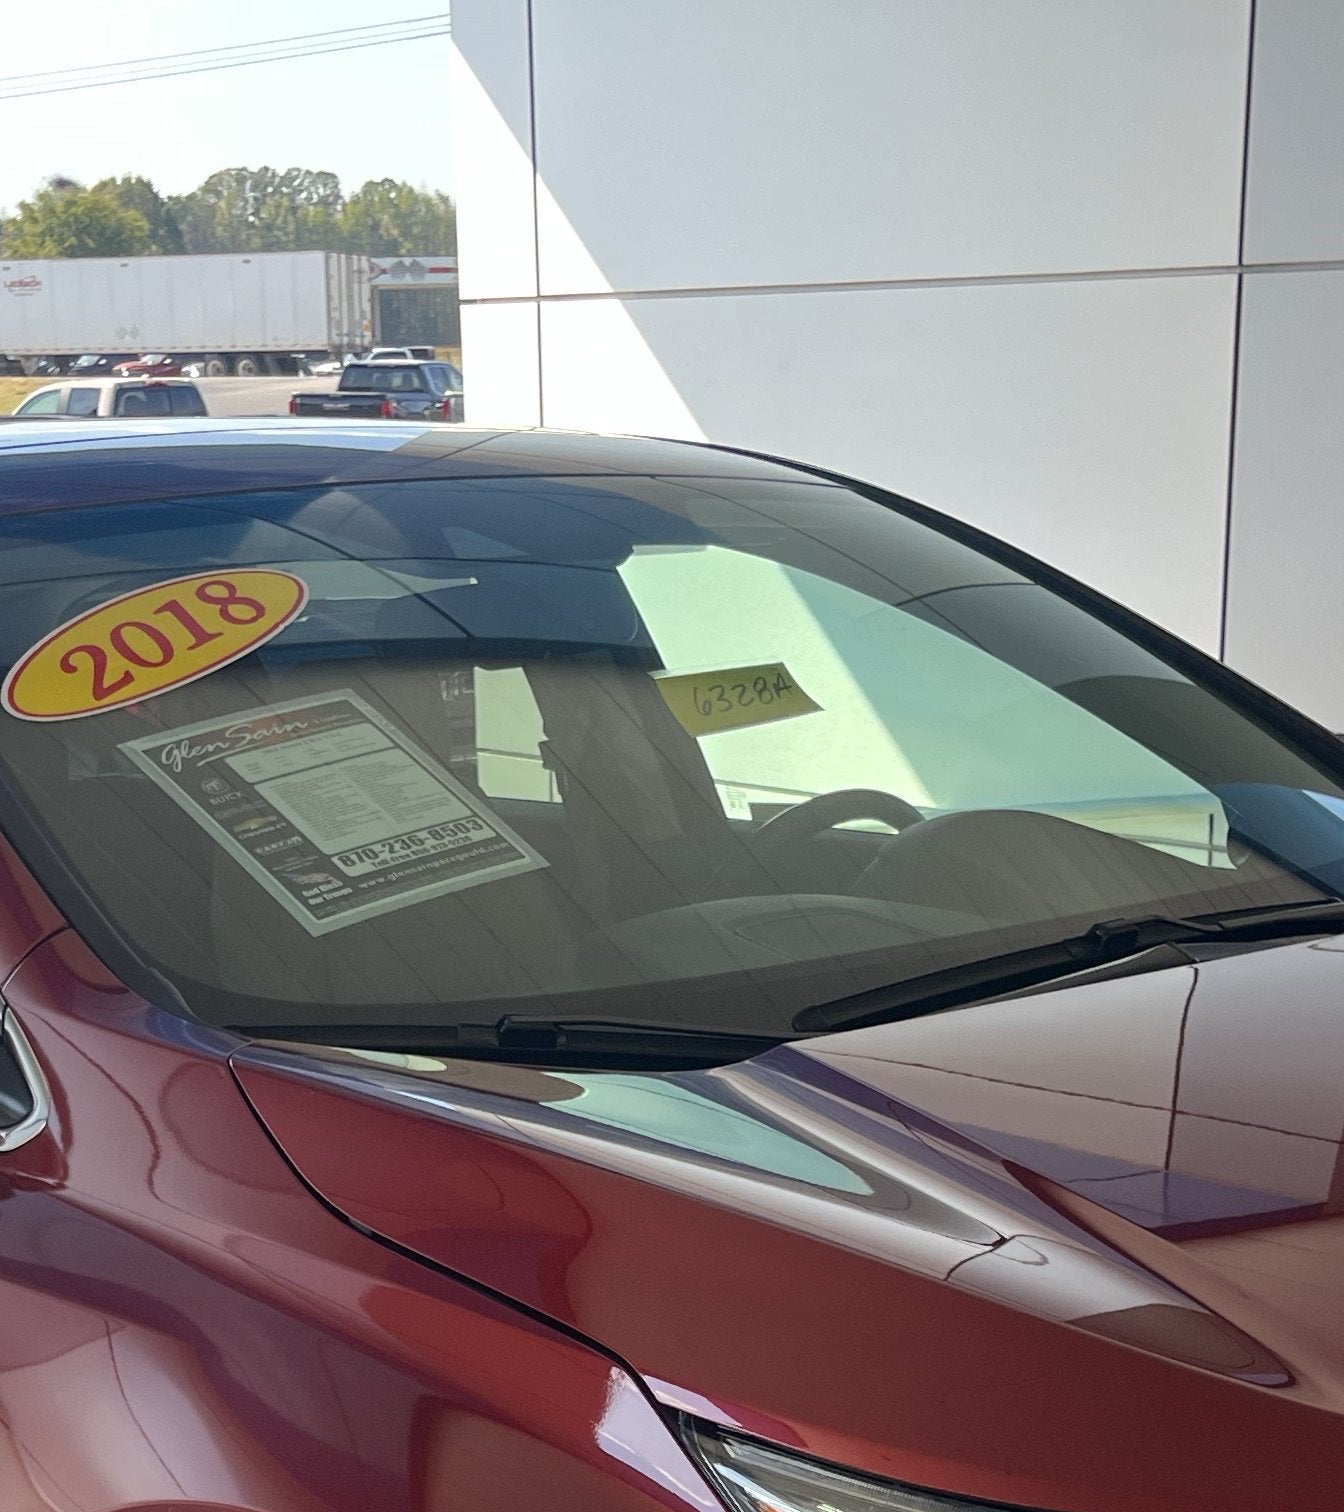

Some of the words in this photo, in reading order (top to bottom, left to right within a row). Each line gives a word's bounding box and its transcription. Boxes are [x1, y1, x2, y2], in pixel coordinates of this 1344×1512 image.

[60, 580, 266, 700] 2018
[693, 673, 793, 716] 6328A
[161, 739, 230, 772] Glen
[225, 720, 308, 748] Sain
[210, 790, 246, 806] BUICK
[337, 818, 484, 868] 870-236-8503
